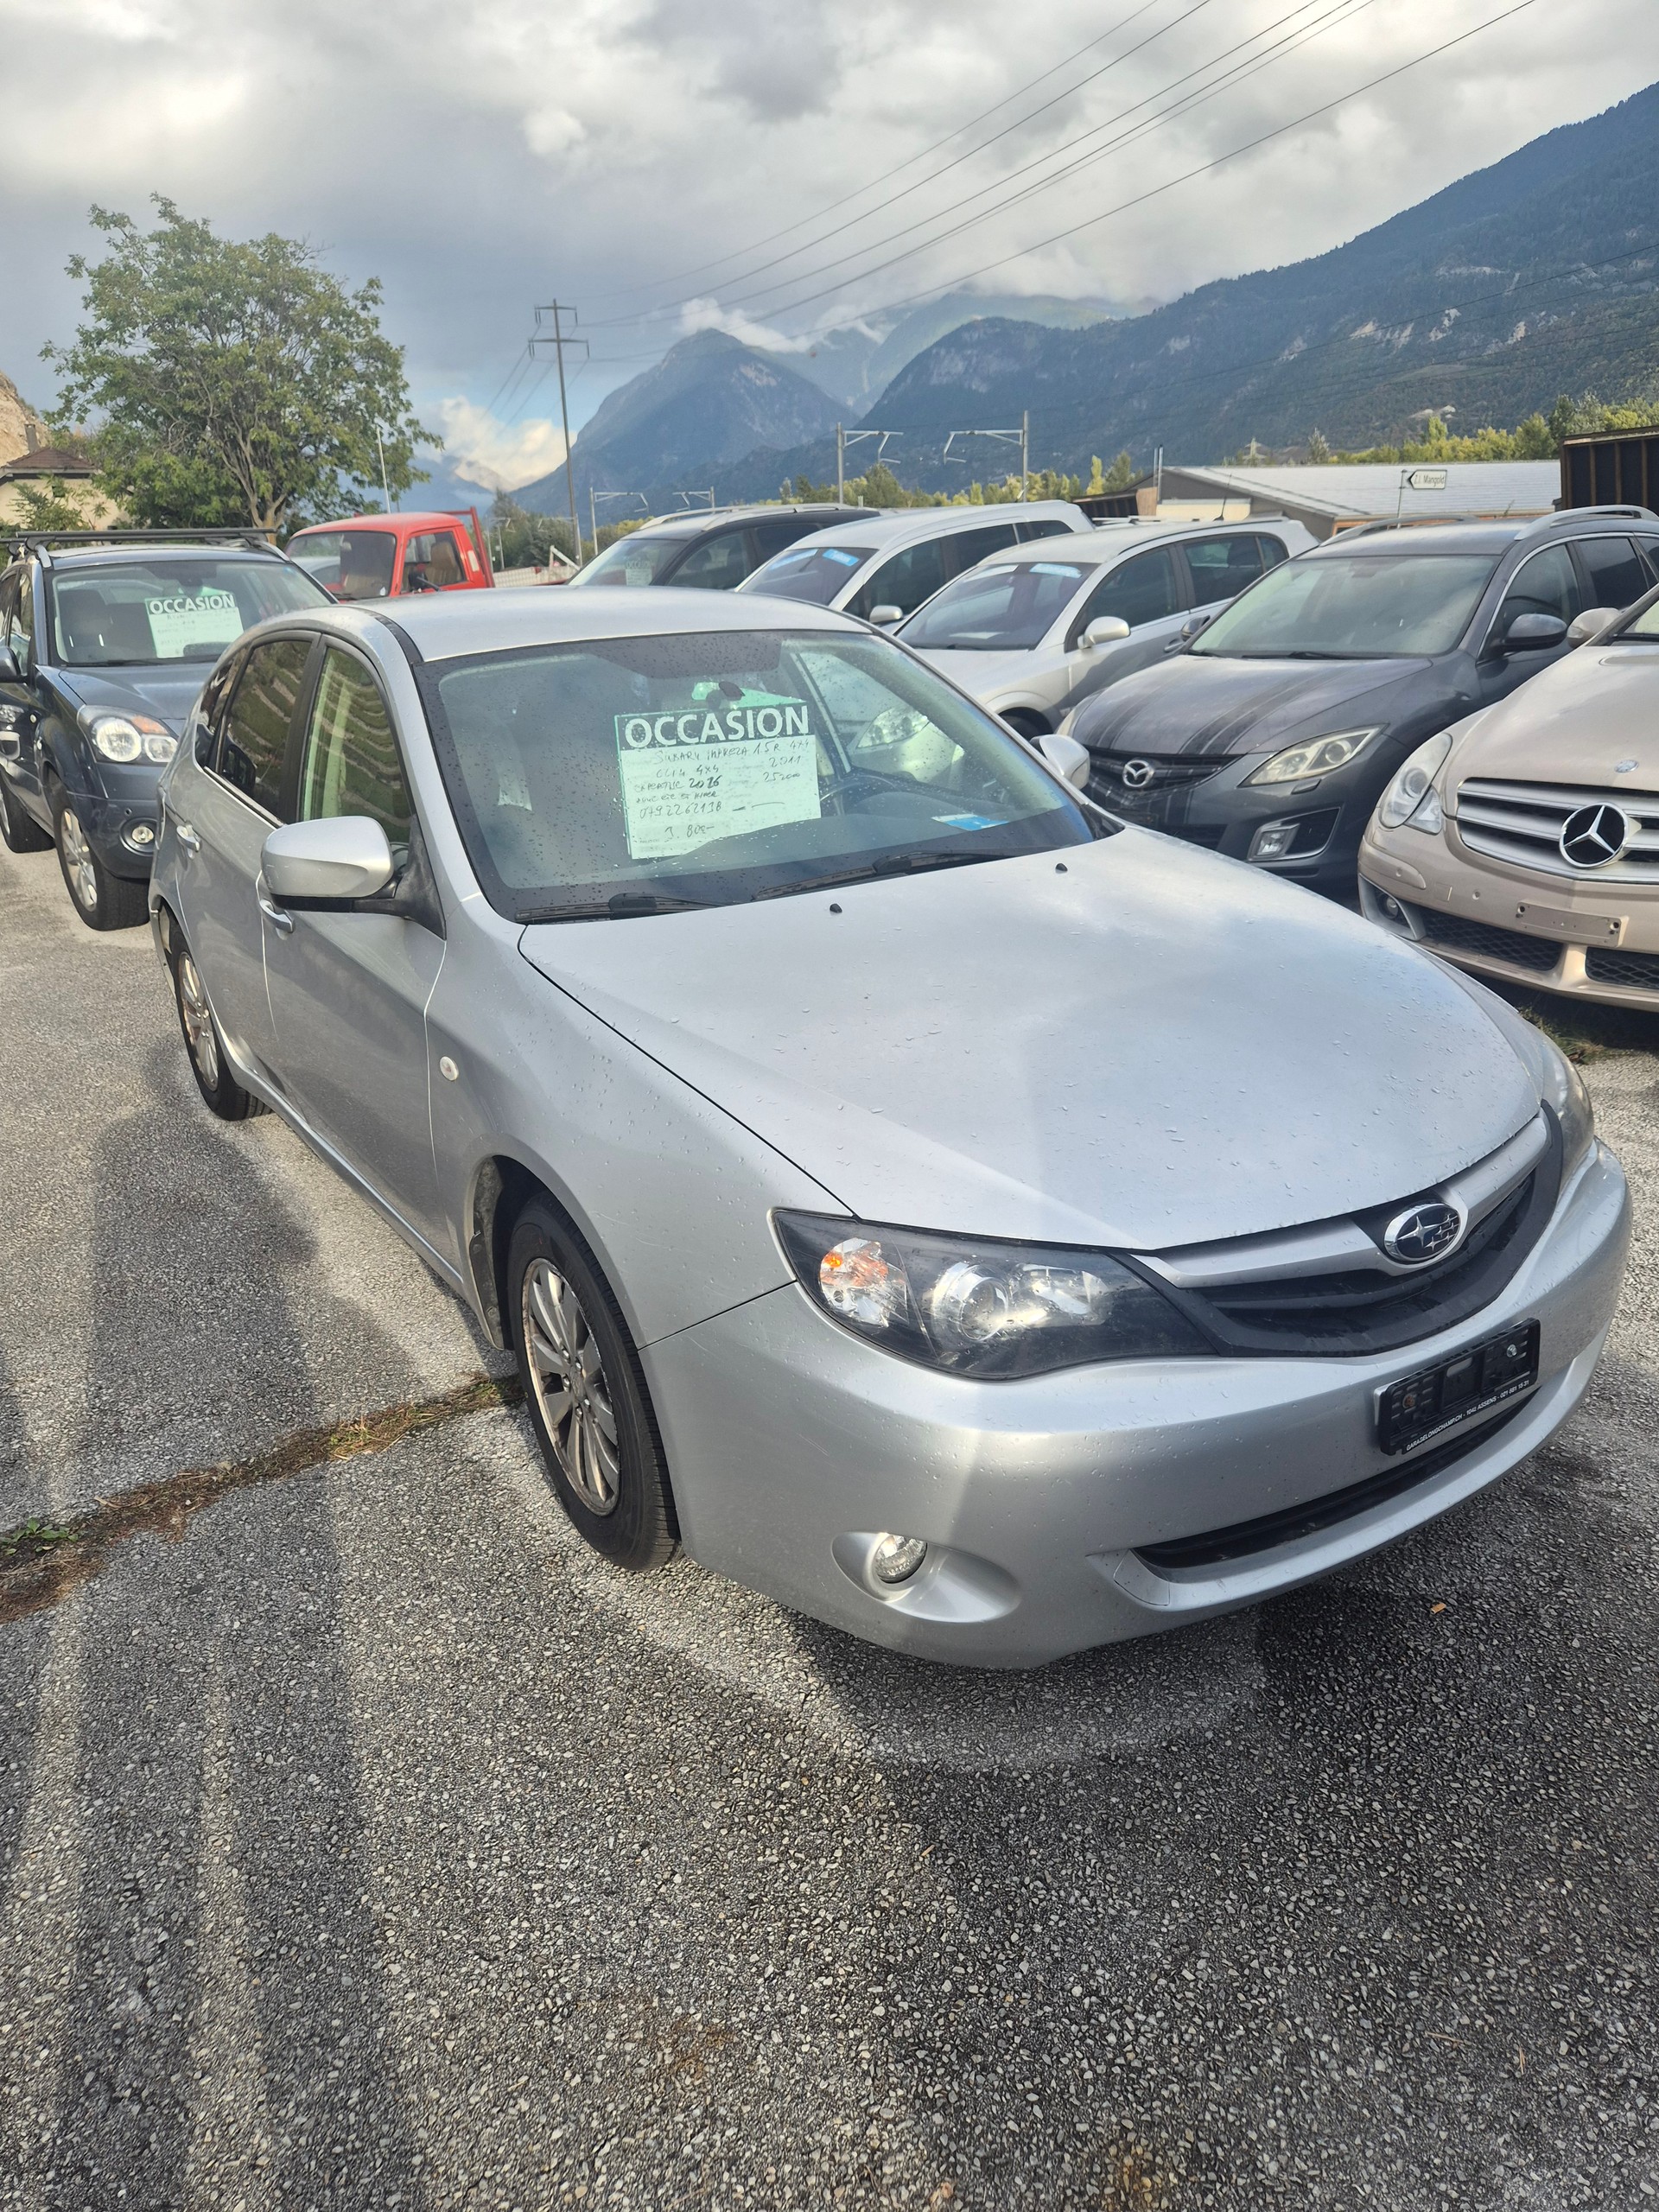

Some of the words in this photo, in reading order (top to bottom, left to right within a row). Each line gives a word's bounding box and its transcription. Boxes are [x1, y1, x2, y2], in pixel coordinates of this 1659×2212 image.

[149, 594, 236, 614] OCCASION
[625, 706, 810, 748] OCCASION
[769, 755, 801, 767] 2011
[689, 775, 722, 790] 2026
[1478, 1396, 1497, 1410] ASSENS
